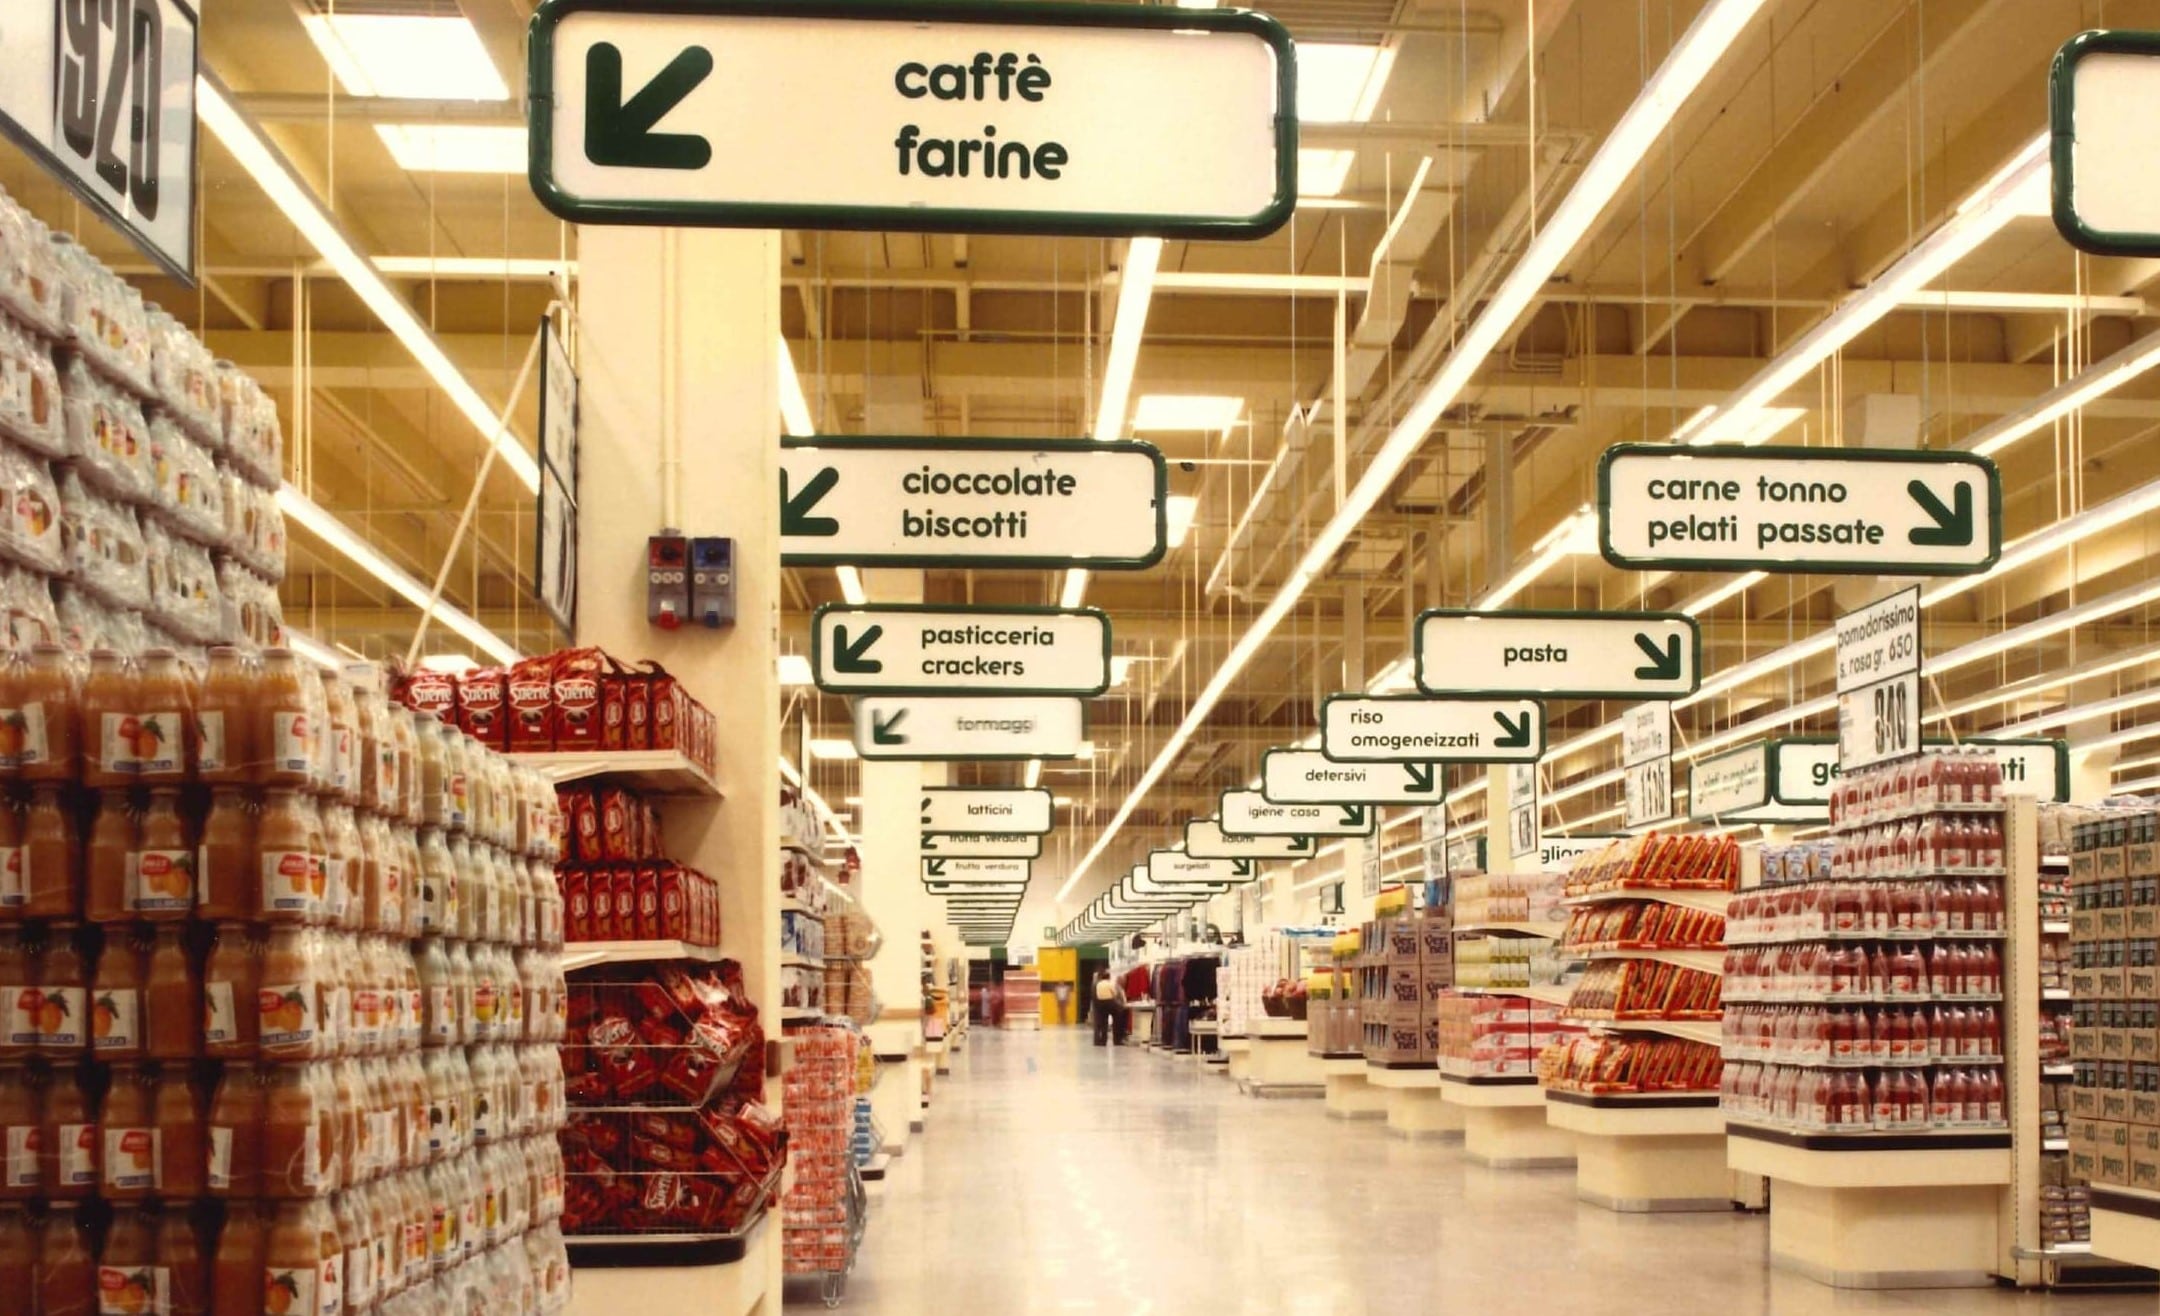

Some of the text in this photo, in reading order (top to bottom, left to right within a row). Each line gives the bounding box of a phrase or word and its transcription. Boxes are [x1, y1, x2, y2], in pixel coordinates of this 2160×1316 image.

[895, 52, 1052, 102] caffè
[62, 0, 162, 222] 920
[895, 124, 1069, 180] farine
[902, 465, 1077, 496] cioccolate
[1647, 476, 1848, 503] carne tonno
[903, 508, 1027, 538] biscotti
[1648, 514, 1884, 549] pelati passate
[921, 625, 1055, 649] pasticceria
[1837, 605, 1915, 653] pomodorissimo
[921, 655, 1025, 676] crackers
[1504, 644, 1567, 667] pasta
[1849, 653, 1872, 675] rosa
[1888, 632, 1913, 661] 650
[1350, 709, 1383, 724] riso
[1351, 732, 1480, 750] omogeneizzati
[1305, 769, 1366, 782] detersivi
[967, 804, 1013, 816] latticini
[1249, 806, 1320, 819] igiene casa
